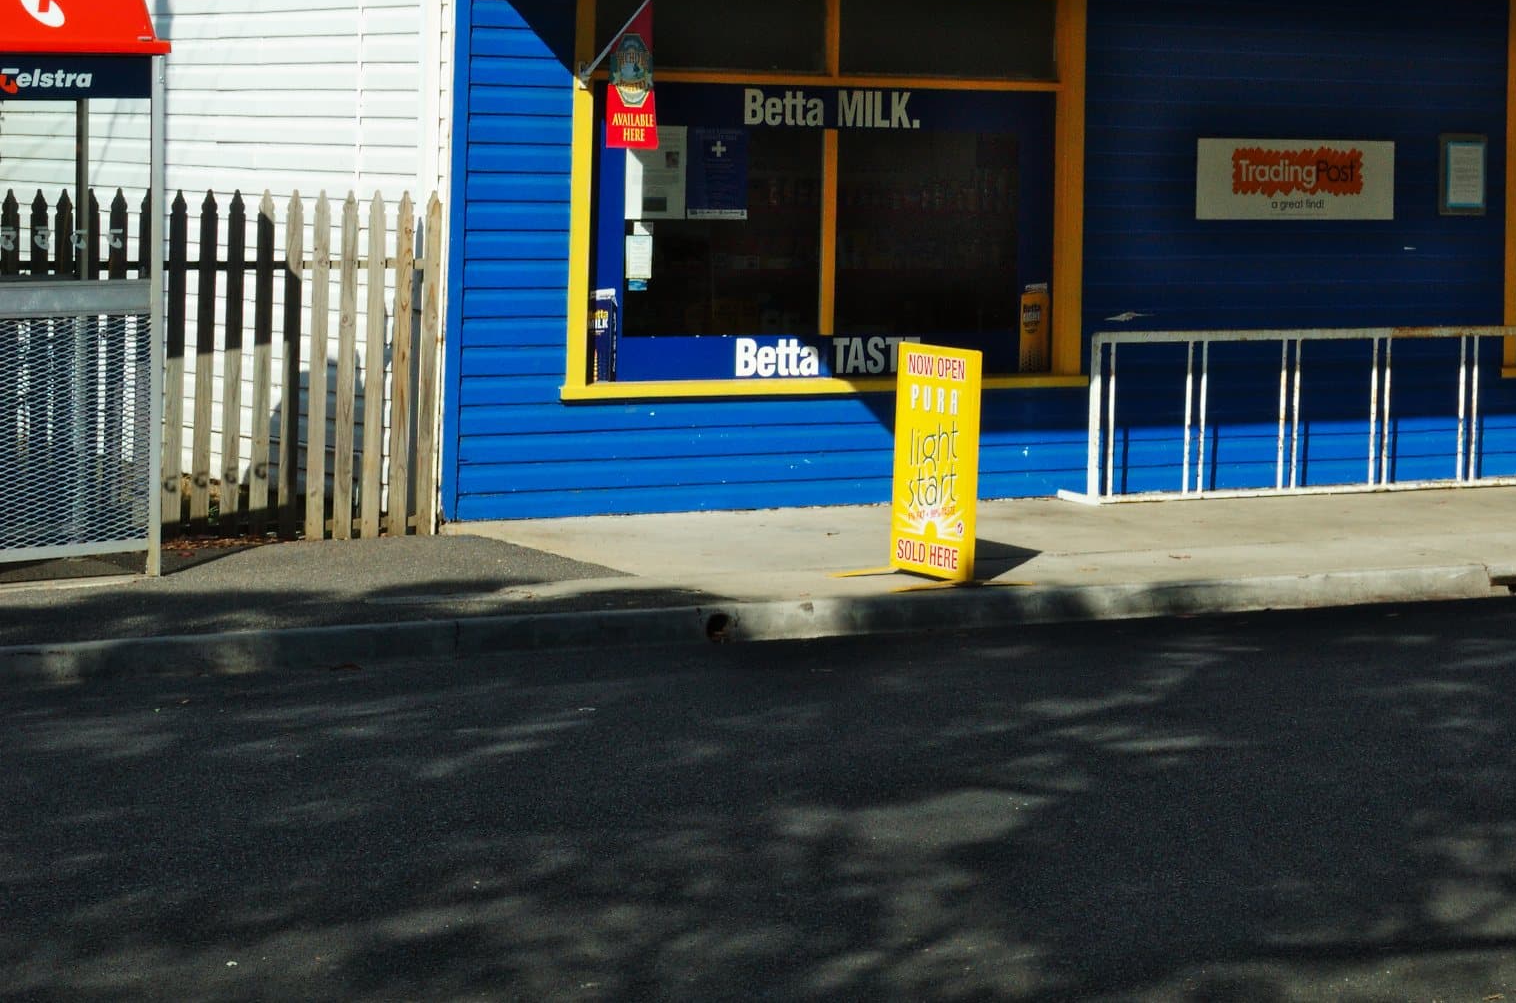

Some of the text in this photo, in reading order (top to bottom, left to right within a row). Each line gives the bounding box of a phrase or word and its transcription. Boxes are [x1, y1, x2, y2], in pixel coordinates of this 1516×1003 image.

[0, 68, 93, 94] Telstra
[612, 112, 654, 127] AVAILABLE
[744, 88, 921, 129] Betta MILK.
[623, 128, 645, 142] HERE
[1280, 199, 1304, 211] great
[735, 337, 921, 377] Betta TAST
[908, 354, 965, 380] NOW OPEN
[910, 383, 958, 415] PURA
[910, 420, 958, 472] light
[908, 464, 957, 507] start
[897, 538, 958, 570] SOLD HERE
